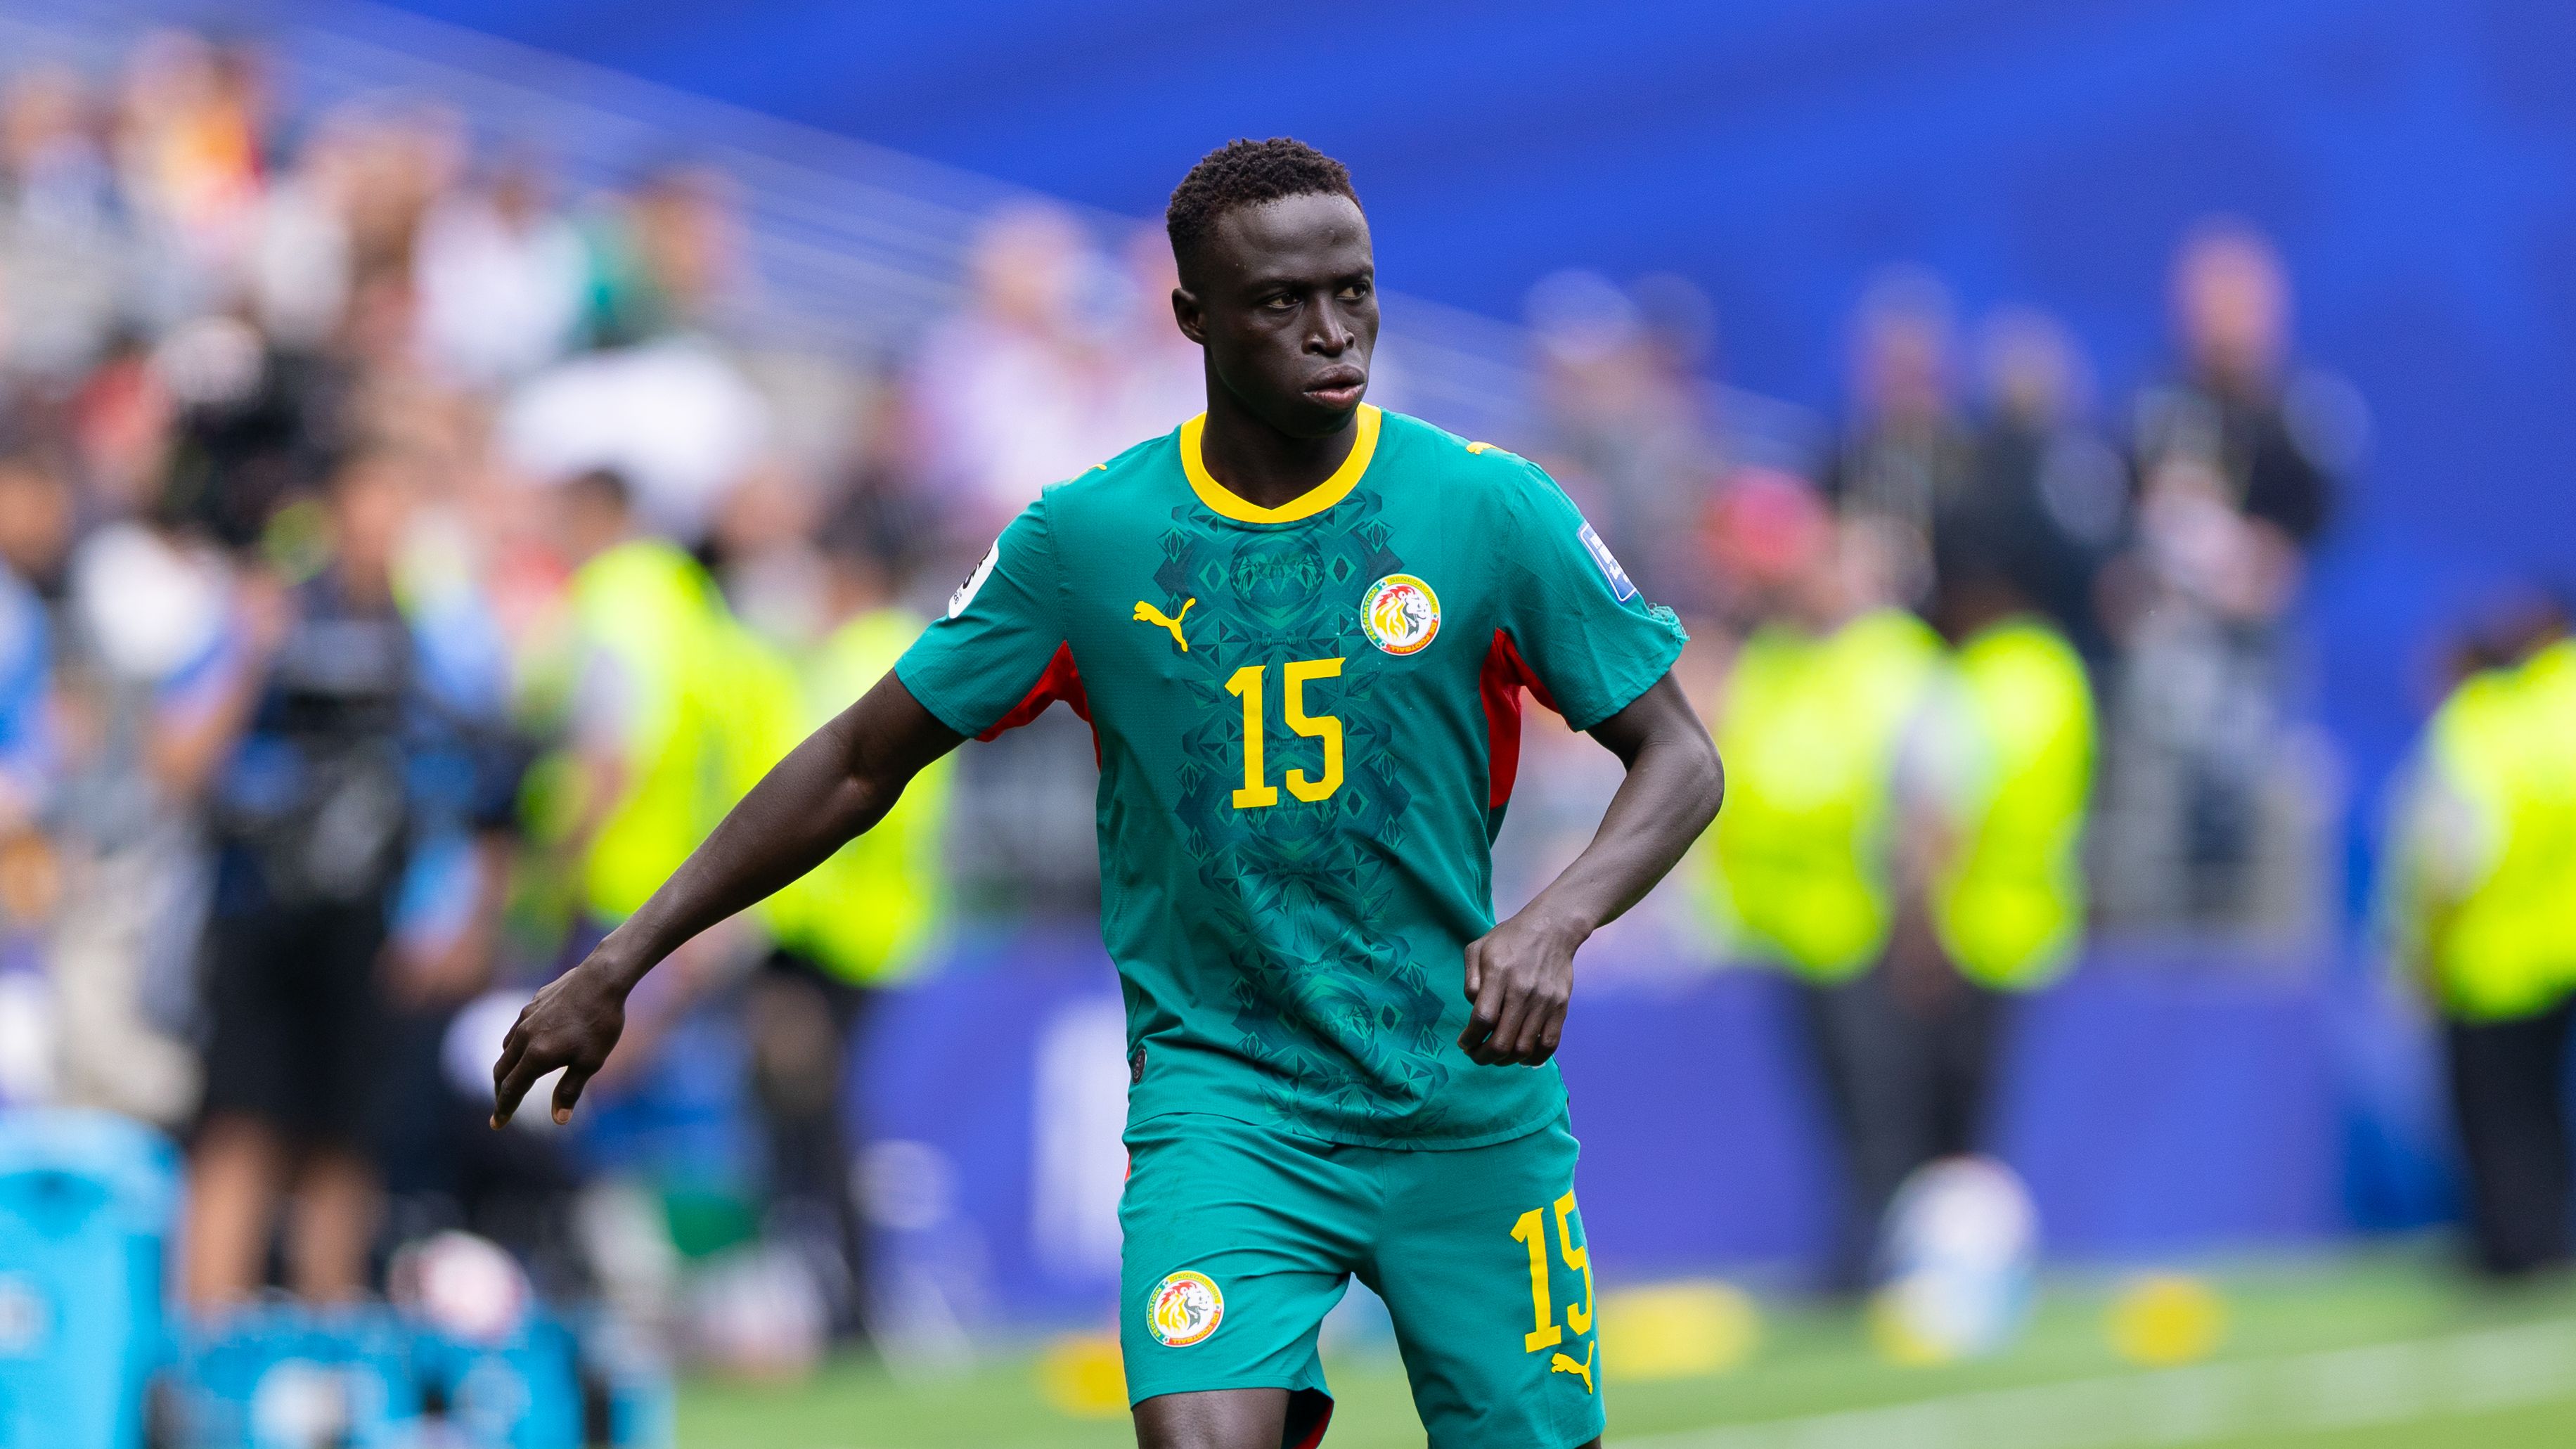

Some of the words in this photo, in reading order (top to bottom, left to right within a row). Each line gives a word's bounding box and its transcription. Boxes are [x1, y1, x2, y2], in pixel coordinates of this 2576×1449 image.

[1429, 622, 1437, 634] DE
[1391, 634, 1431, 653] FOOTBALL
[1224, 657, 1346, 809] 15
[1509, 1188, 1592, 1353] 15
[1211, 1313, 1220, 1325] DE
[1172, 1325, 1213, 1344] FOOTBALL
